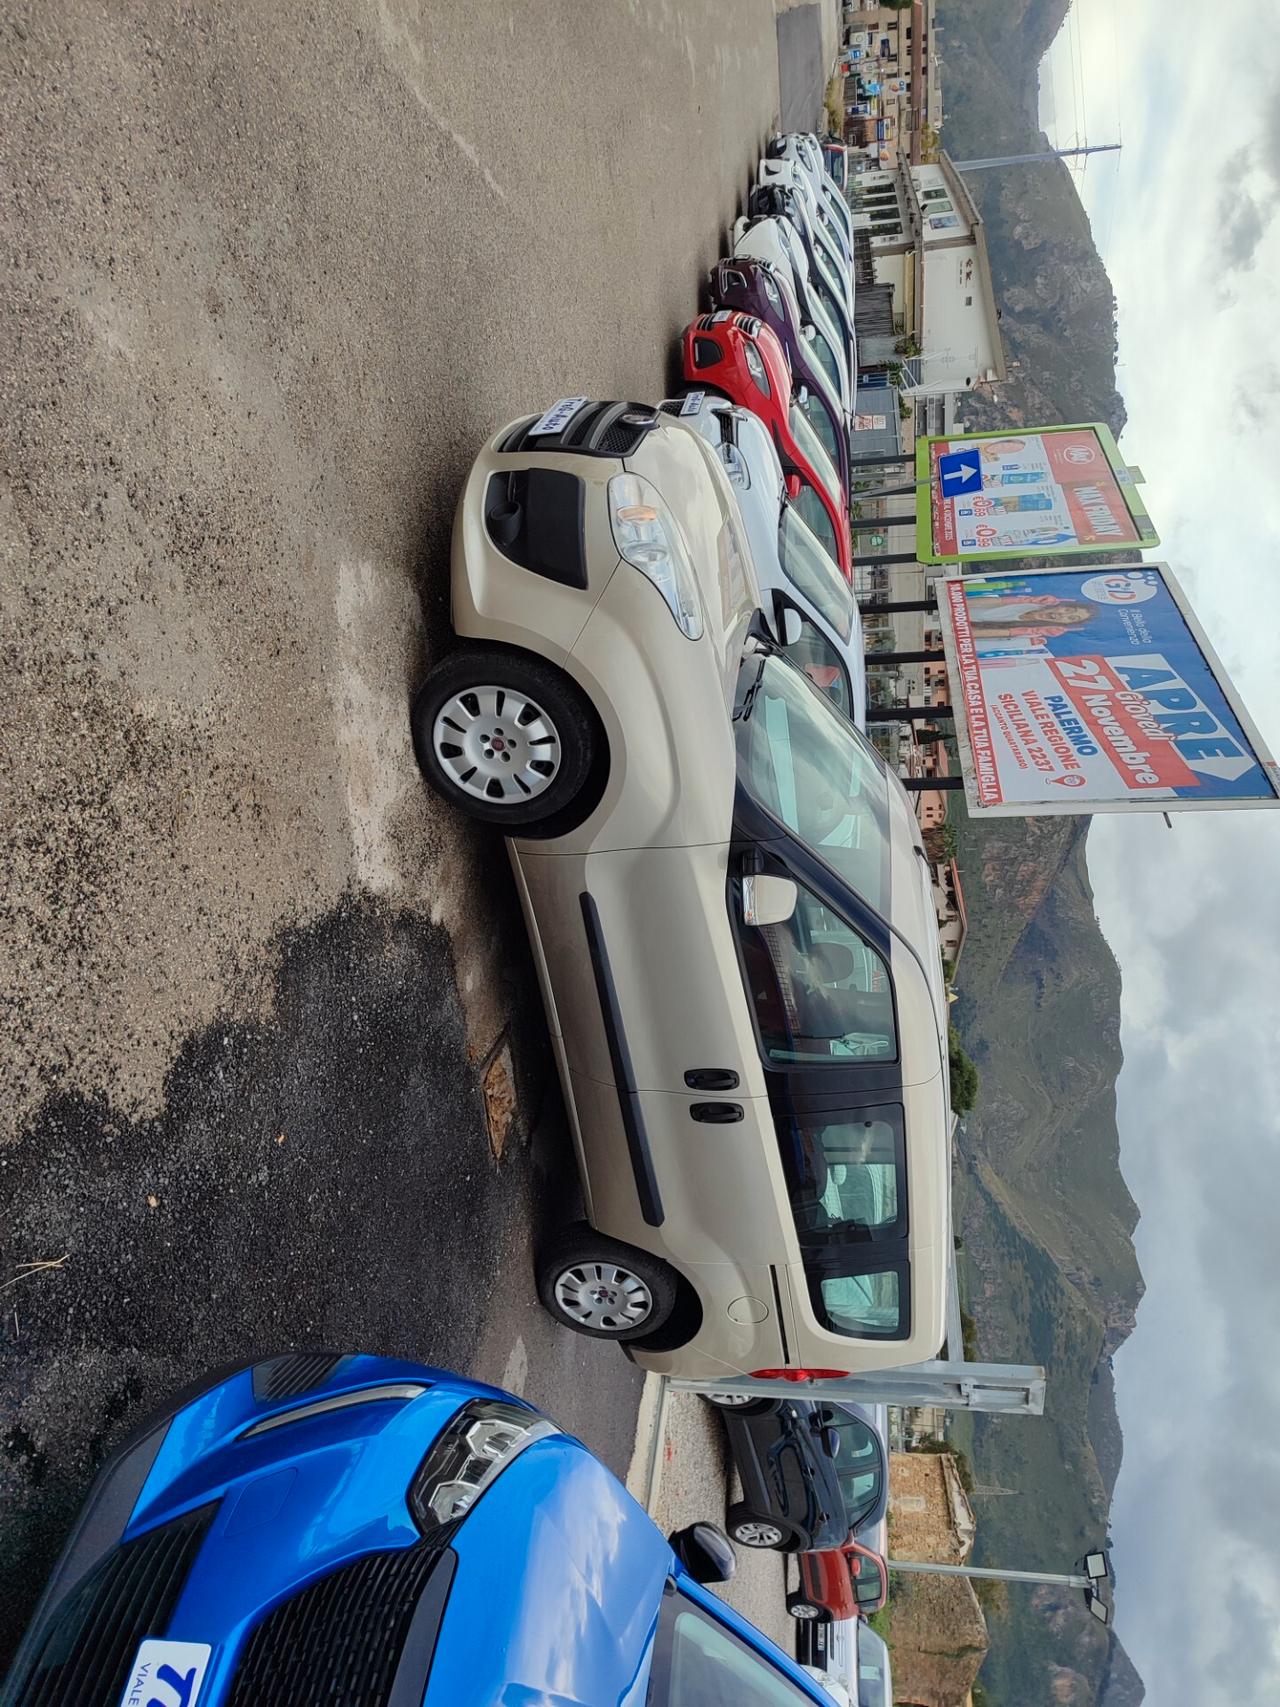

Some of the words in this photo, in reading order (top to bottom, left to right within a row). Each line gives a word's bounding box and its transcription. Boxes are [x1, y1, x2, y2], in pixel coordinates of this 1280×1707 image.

[1073, 486, 1106, 505] MAX
[1082, 505, 1124, 536] FRIDAY
[949, 583, 961, 603] 10.000
[952, 603, 969, 638] PRODOTTI
[1118, 608, 1140, 645] Convenienza
[1138, 628, 1153, 643] della
[958, 638, 973, 654] PER
[962, 654, 975, 665] LA
[963, 665, 977, 681] TUA
[1054, 659, 1114, 691] 27
[966, 683, 981, 707] CASA
[972, 714, 984, 728] LA
[1044, 695, 1099, 756] PALERMO
[1114, 666, 1245, 761] APRE
[1115, 691, 1178, 741] Giovedì
[974, 729, 990, 749] TUA
[998, 693, 1038, 745] SICILIANA
[1027, 747, 1054, 772] 2237
[1021, 690, 1049, 720] VIALE
[1038, 721, 1081, 771] REGIONE
[1081, 693, 1159, 784] Novembre
[977, 749, 998, 801] FAMIGLIA
[127, 1663, 152, 1706] VIALE
